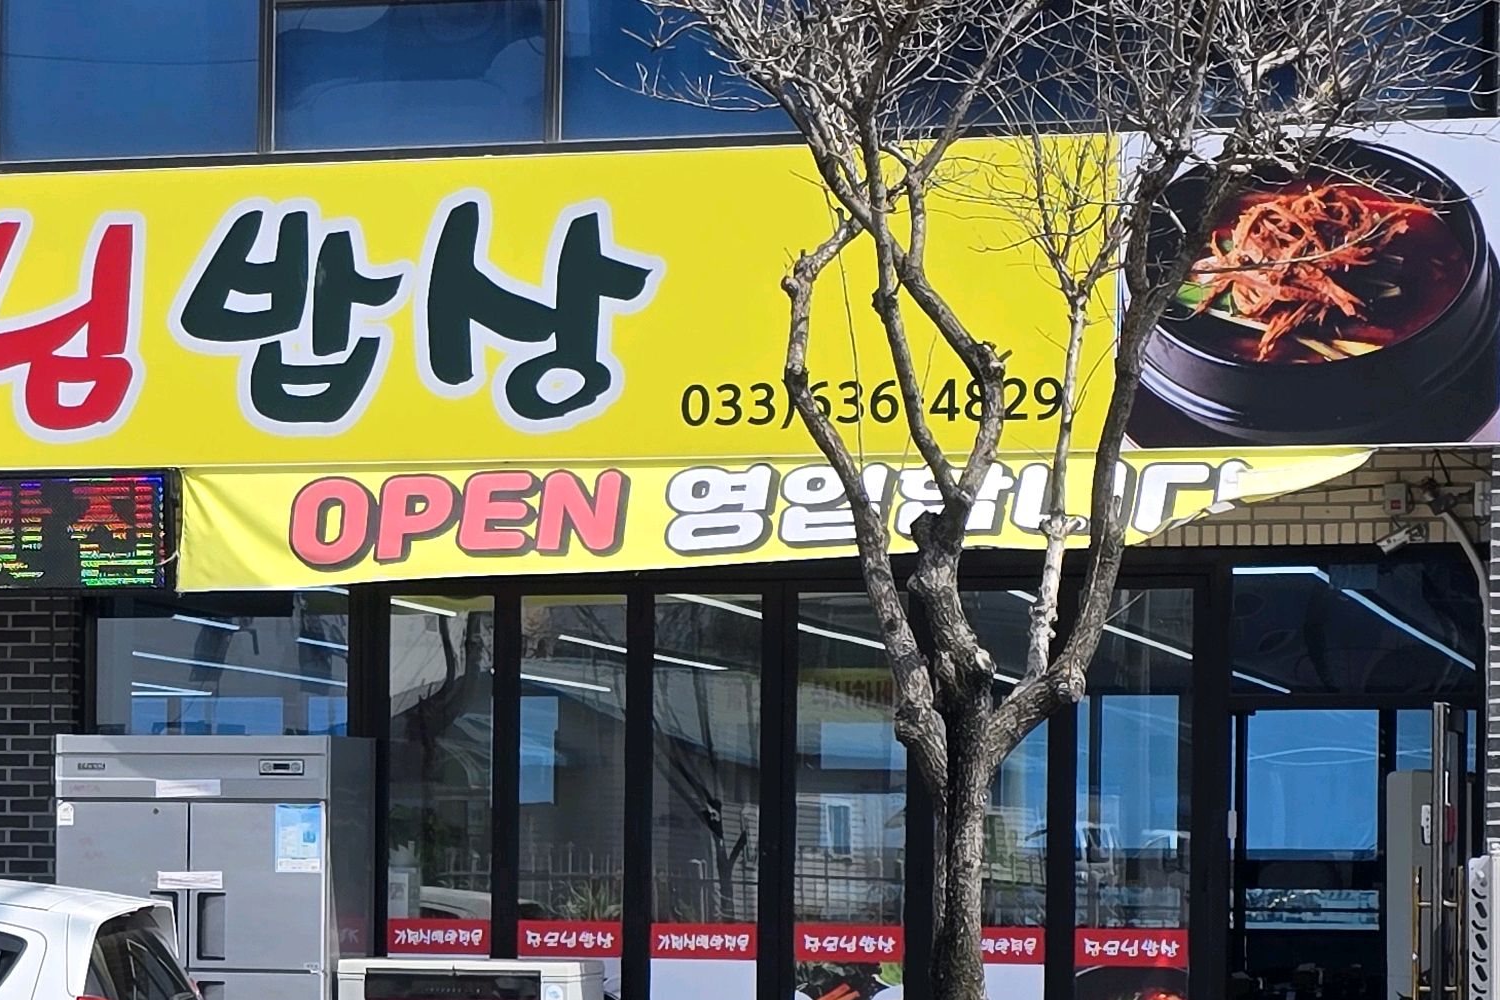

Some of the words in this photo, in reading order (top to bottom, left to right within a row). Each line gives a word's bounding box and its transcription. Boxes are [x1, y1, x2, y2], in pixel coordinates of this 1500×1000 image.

[681, 377, 1064, 430] 033)6364829
[290, 468, 628, 571] OPEN
[981, 937, 1037, 956] 백반전문
